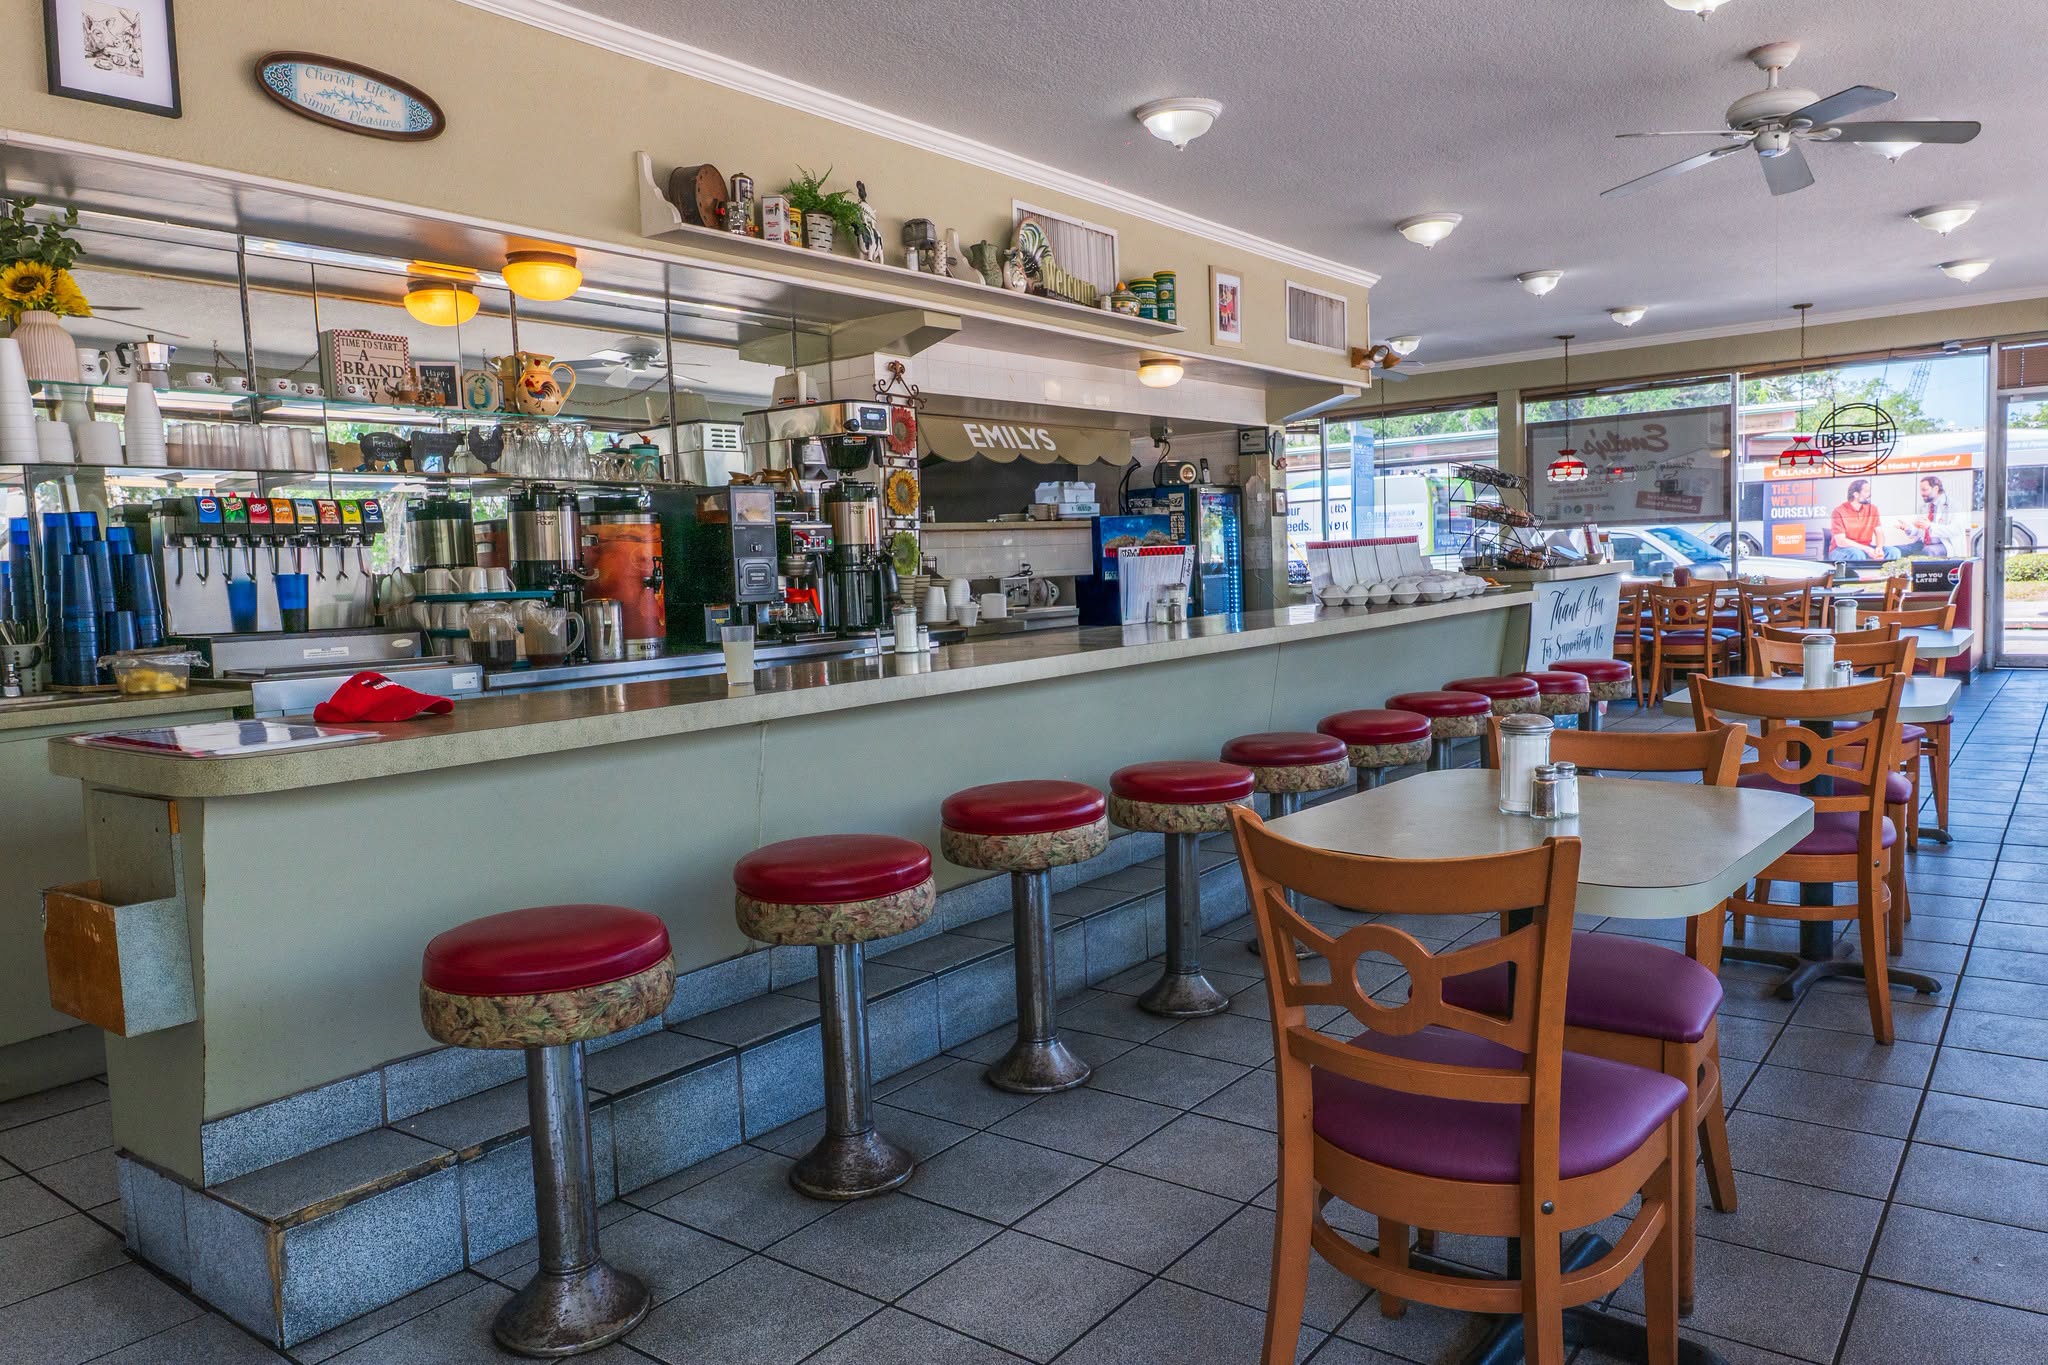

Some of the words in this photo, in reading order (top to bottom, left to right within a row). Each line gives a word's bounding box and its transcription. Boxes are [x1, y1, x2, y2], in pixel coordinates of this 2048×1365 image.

[305, 66, 355, 87] Cherish
[364, 81, 396, 102] Life's
[301, 92, 340, 116] Simple
[348, 109, 401, 128] Pleasures
[341, 337, 361, 348] TIME
[363, 339, 373, 348] TO
[359, 350, 369, 362] A
[343, 360, 404, 379] BRAND
[344, 376, 380, 391] NEW
[962, 423, 1057, 451] EMILYS
[1771, 484, 1790, 495] THE
[1771, 506, 1828, 518] OURSELVES.
[1287, 520, 1312, 531] eeds.
[1550, 587, 1585, 630] Thank
[1584, 585, 1604, 627] You
[1541, 636, 1554, 664] For
[1555, 629, 1592, 660] Supporting
